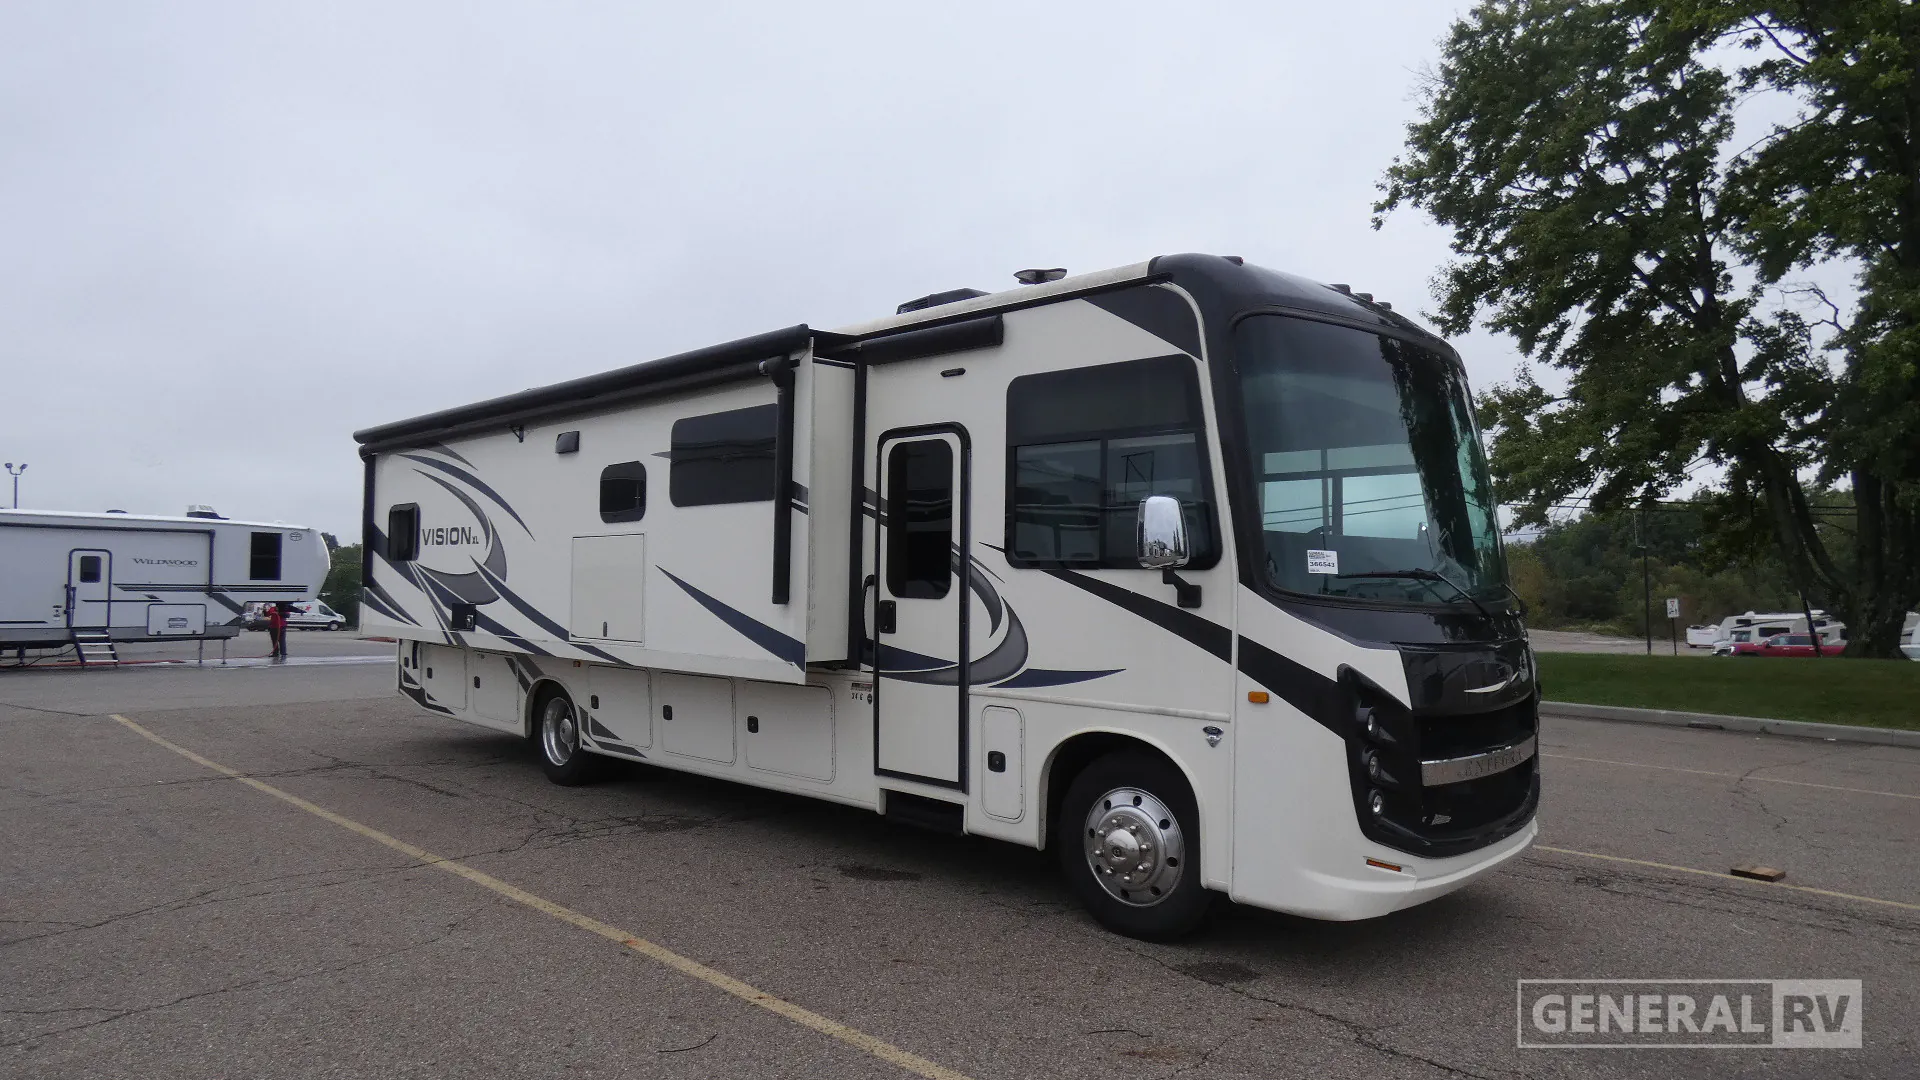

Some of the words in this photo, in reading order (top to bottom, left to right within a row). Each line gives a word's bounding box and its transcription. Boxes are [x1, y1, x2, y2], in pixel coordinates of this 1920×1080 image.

[422, 527, 471, 546] VISION
[472, 535, 479, 545] XL
[132, 558, 198, 566] WILDWOOD
